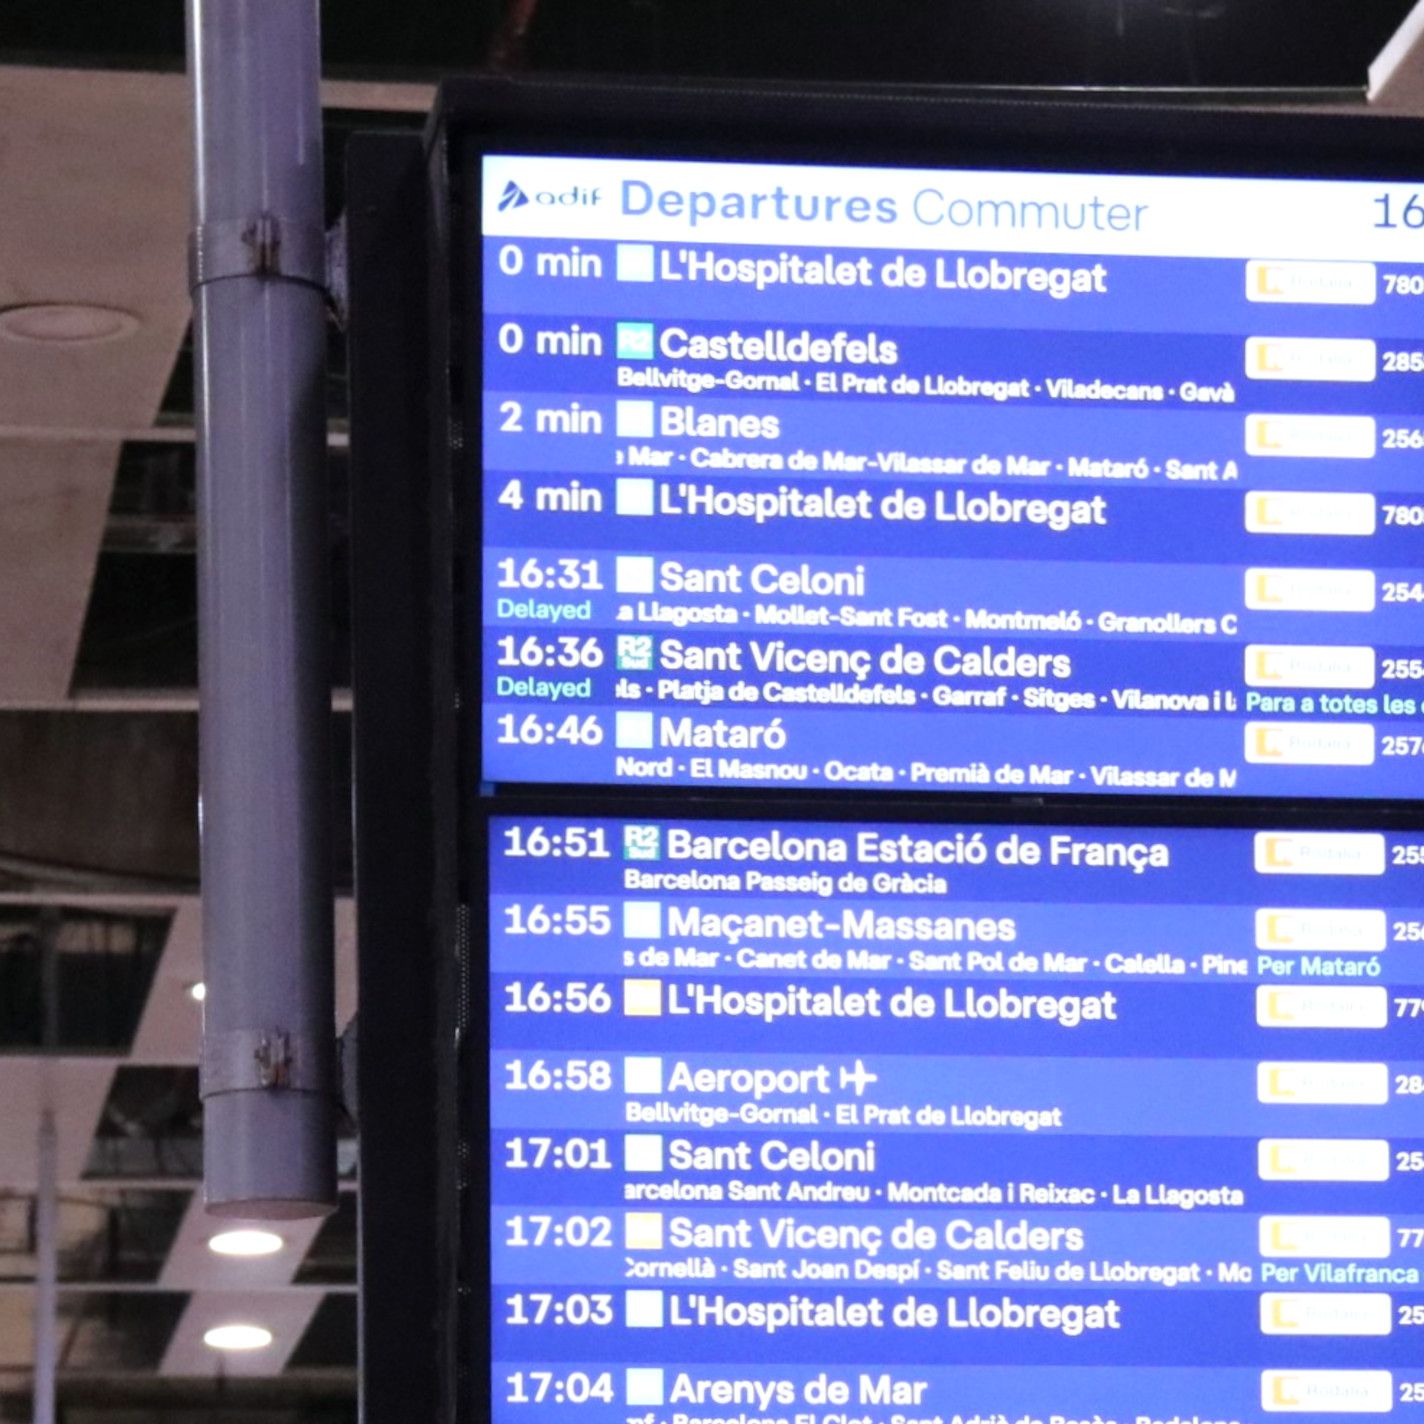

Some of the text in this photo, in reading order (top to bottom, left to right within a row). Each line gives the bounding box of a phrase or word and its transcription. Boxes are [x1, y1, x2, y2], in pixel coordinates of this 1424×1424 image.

[622, 179, 898, 226] Departures
[913, 188, 1148, 230] Commuter
[498, 244, 524, 275] 0
[536, 246, 603, 278] min
[662, 249, 873, 291] L'Hospitalet
[881, 256, 927, 288] de
[935, 257, 1108, 299] Llobregat
[498, 323, 523, 353] 0
[536, 324, 601, 355] min
[662, 327, 898, 365] Castelldefels
[617, 366, 1235, 403] Bellvitge-Gornal El Prat de Llobregat Viladecans Gavà
[499, 401, 523, 432] 2
[536, 401, 602, 434] min
[662, 405, 780, 440] Blanes
[497, 557, 603, 591] 16:31
[661, 561, 743, 594] Sant
[750, 563, 865, 596] Celoni
[496, 598, 591, 623] Delayed
[497, 635, 603, 668] 16:36
[661, 638, 742, 671] Sant
[750, 641, 871, 681] Vicenç
[879, 643, 925, 675] de
[933, 644, 1071, 678] Calders
[496, 676, 591, 701] Delayed
[1246, 692, 1295, 712] Para
[1300, 697, 1314, 713] a
[1319, 694, 1378, 714] totes
[1384, 694, 1416, 715] les
[497, 713, 787, 750] 16:46 Mataró
[616, 756, 1215, 788] Nord El Masnou Ocata Premià de Mar Vilassar de
[504, 826, 610, 858] 16:51
[668, 829, 847, 862] Barcelona
[857, 832, 988, 864] Estació
[996, 834, 1041, 865] de
[1050, 835, 1169, 874] França
[624, 868, 948, 897] Barcelona Passeig de Gràcia
[505, 903, 1017, 945] 16:55 Maçanet-Massanes
[1257, 955, 1381, 977] Per Mataró
[505, 1059, 613, 1092] 16:58
[669, 1061, 831, 1101] Aeroport
[1261, 1262, 1299, 1283] Per
[1303, 1262, 1420, 1284] Vilafranca
[506, 1371, 929, 1412] 17:04 Arenys de Mar
